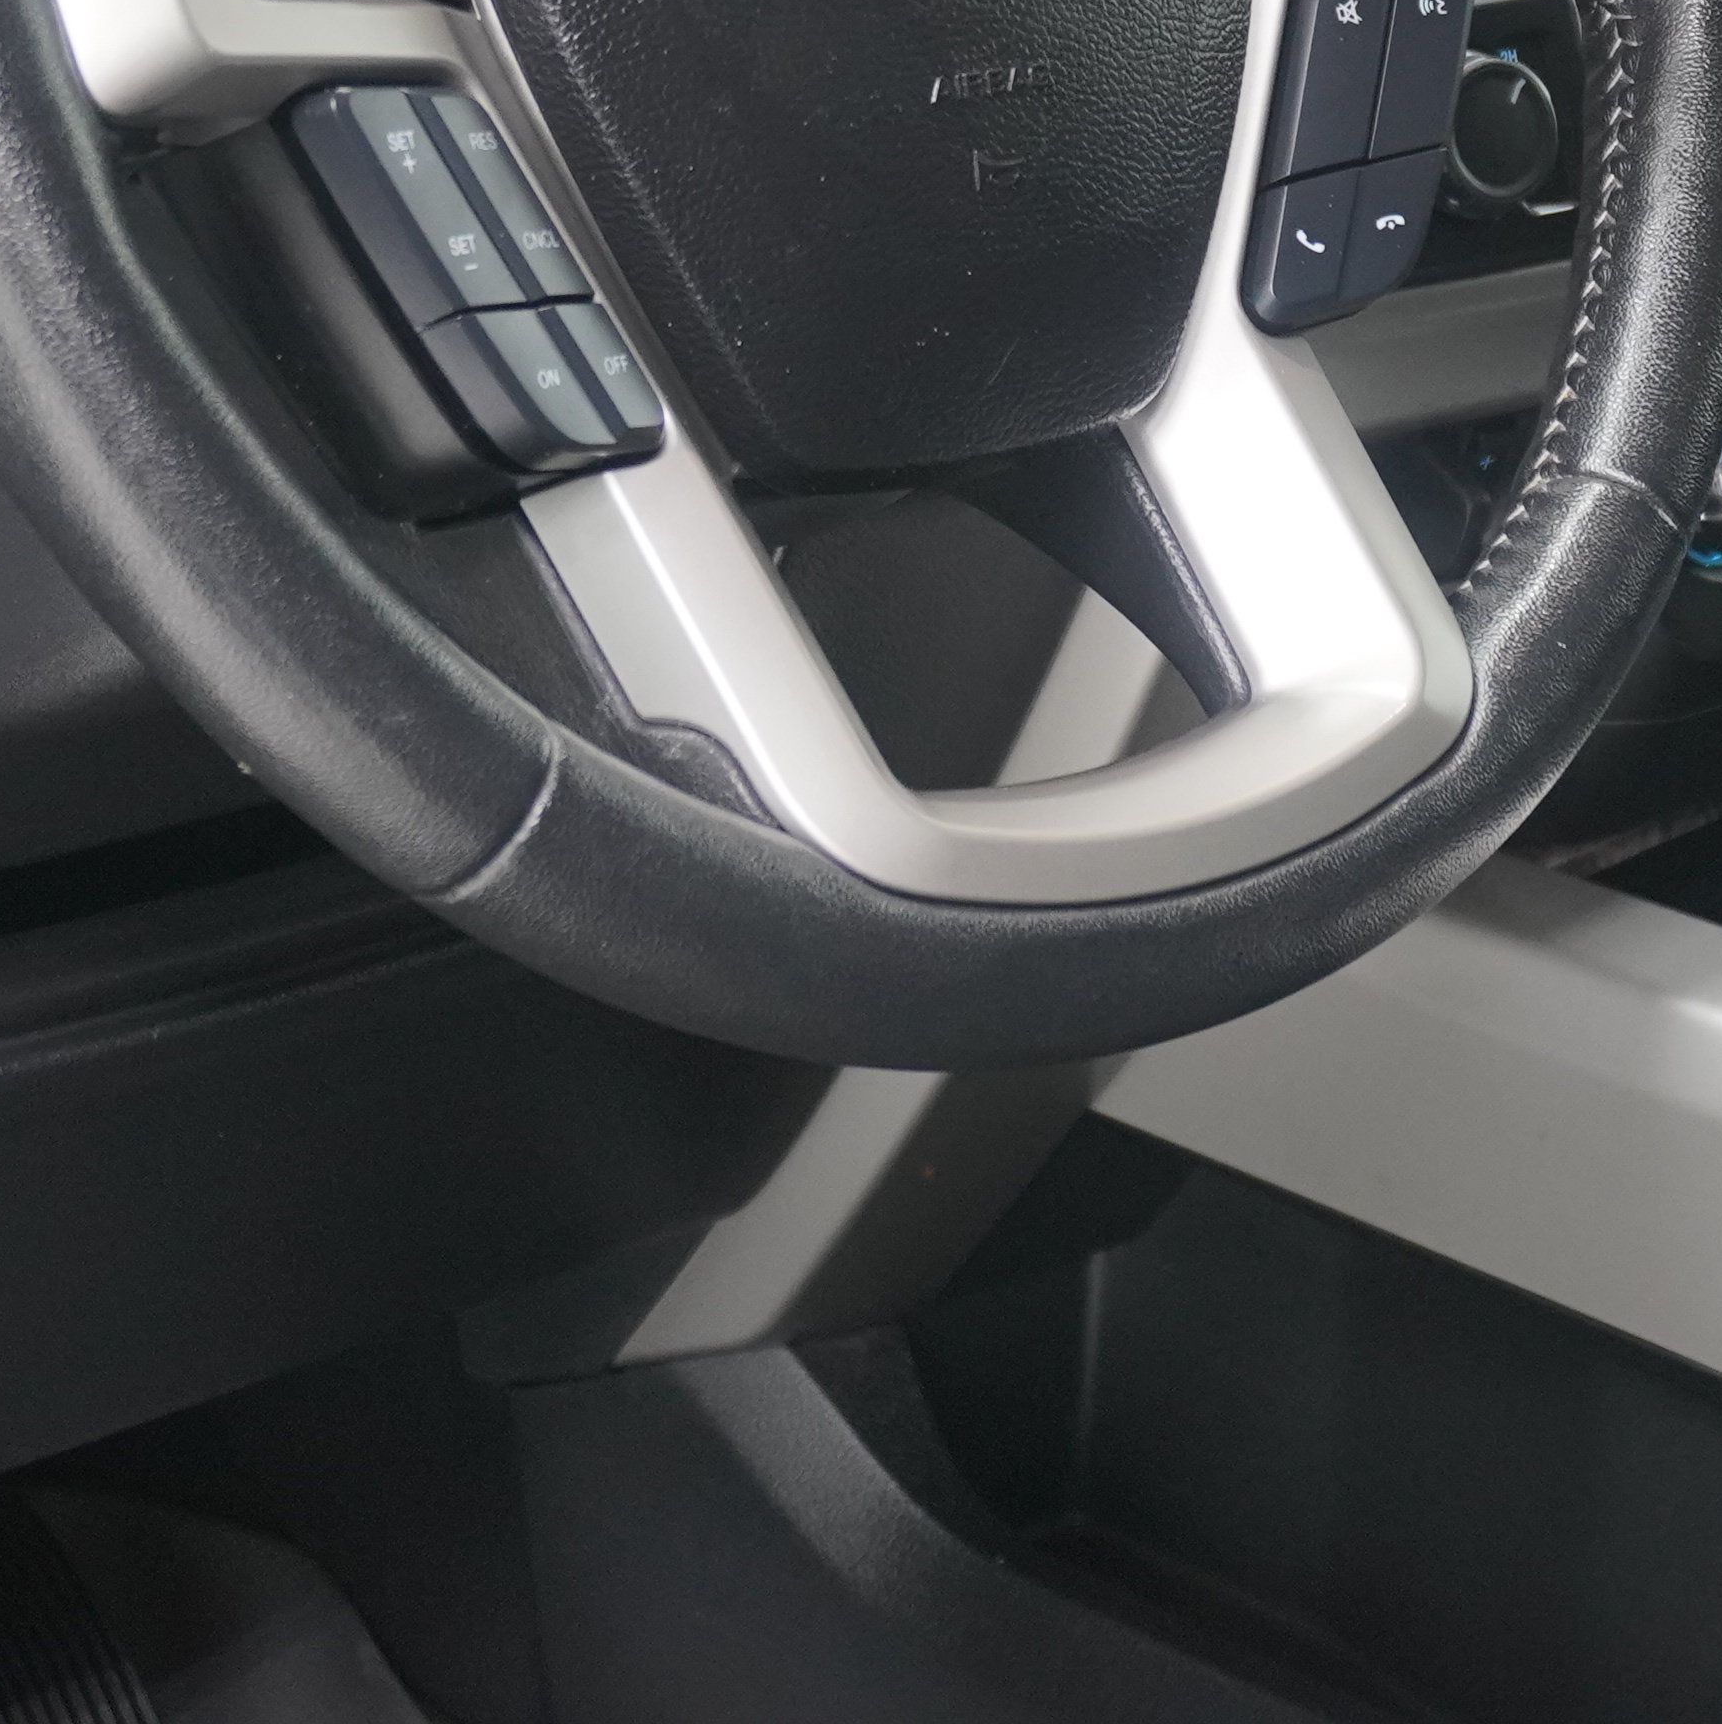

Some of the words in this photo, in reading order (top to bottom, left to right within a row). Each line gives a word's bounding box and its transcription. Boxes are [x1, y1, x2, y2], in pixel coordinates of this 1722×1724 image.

[386, 130, 415, 153] SET
[468, 131, 499, 152] RES
[447, 234, 477, 257] SET
[522, 230, 561, 251] CNCL
[603, 355, 629, 376] OFF
[537, 369, 561, 389] ON
